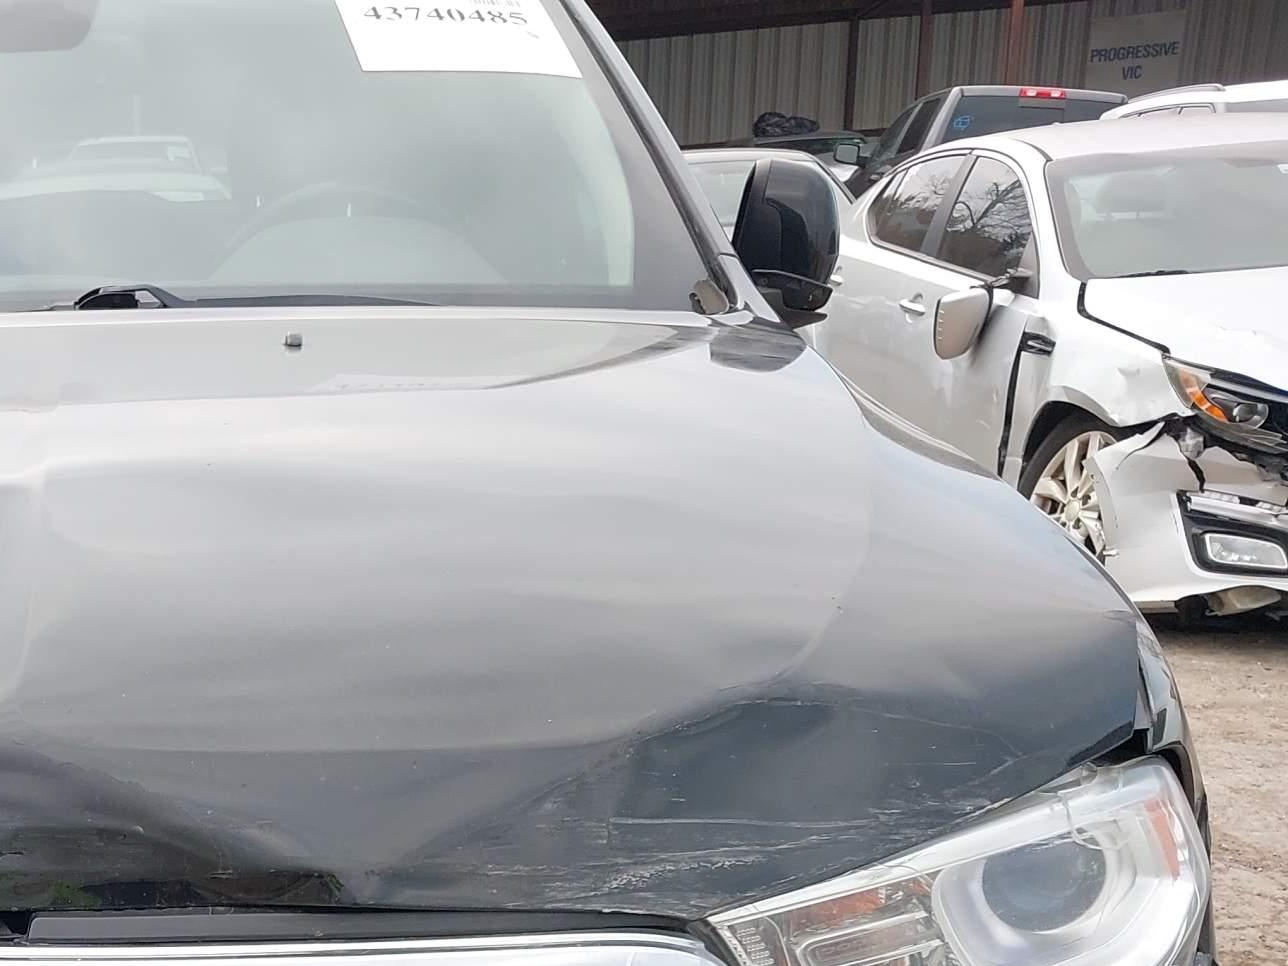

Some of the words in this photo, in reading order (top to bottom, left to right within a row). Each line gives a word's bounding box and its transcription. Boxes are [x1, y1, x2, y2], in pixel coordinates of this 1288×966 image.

[362, 5, 528, 26] 43740485
[1089, 41, 1181, 63] PROGRESSIVE
[1121, 65, 1143, 81] VIC
